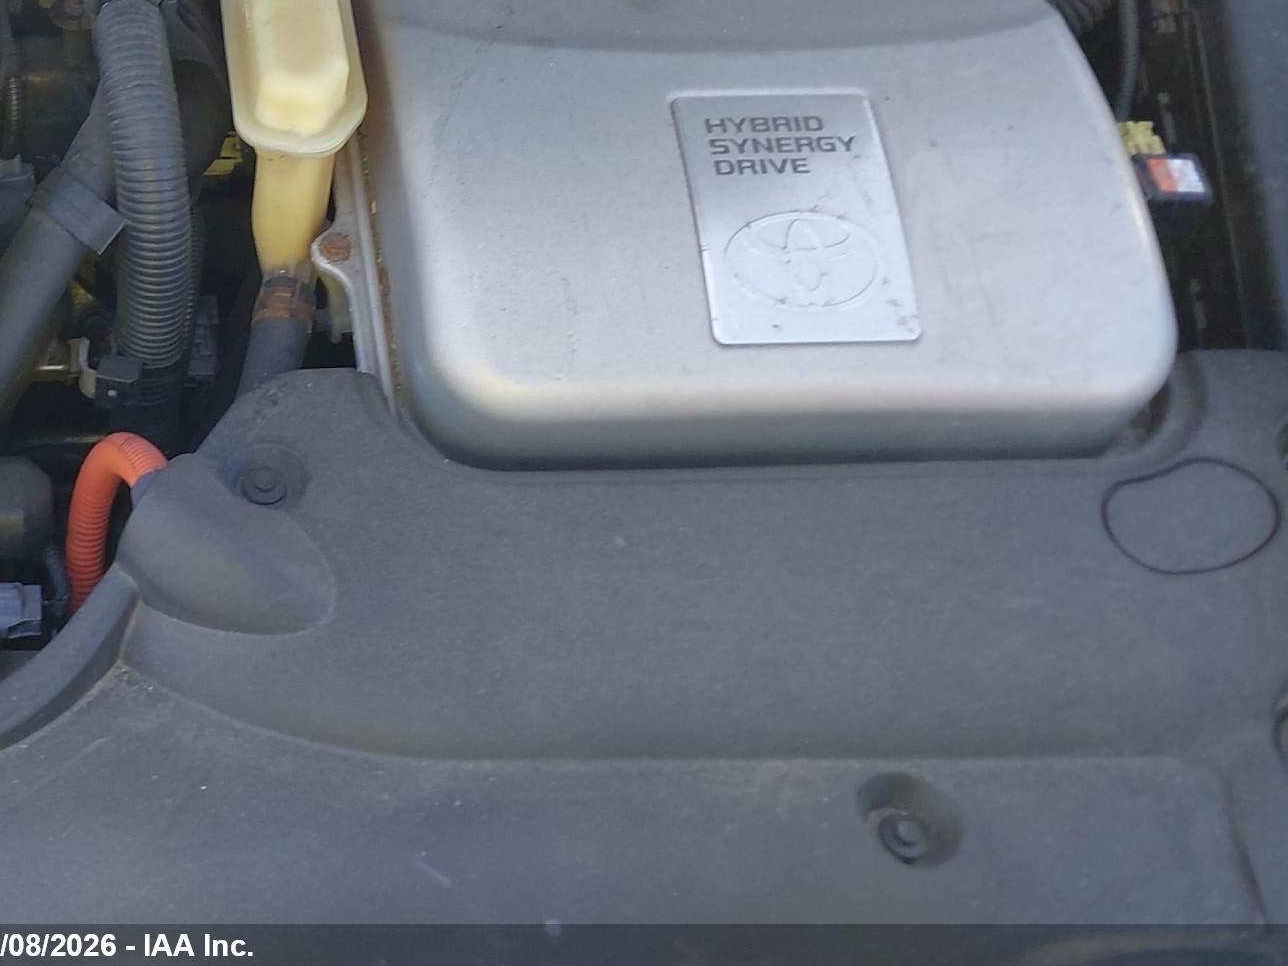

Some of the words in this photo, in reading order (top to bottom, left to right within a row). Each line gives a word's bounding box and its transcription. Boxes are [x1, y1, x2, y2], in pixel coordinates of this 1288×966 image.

[704, 115, 824, 134] HYBRID
[708, 135, 856, 155] SYNERGY
[714, 157, 811, 176] DRIVE
